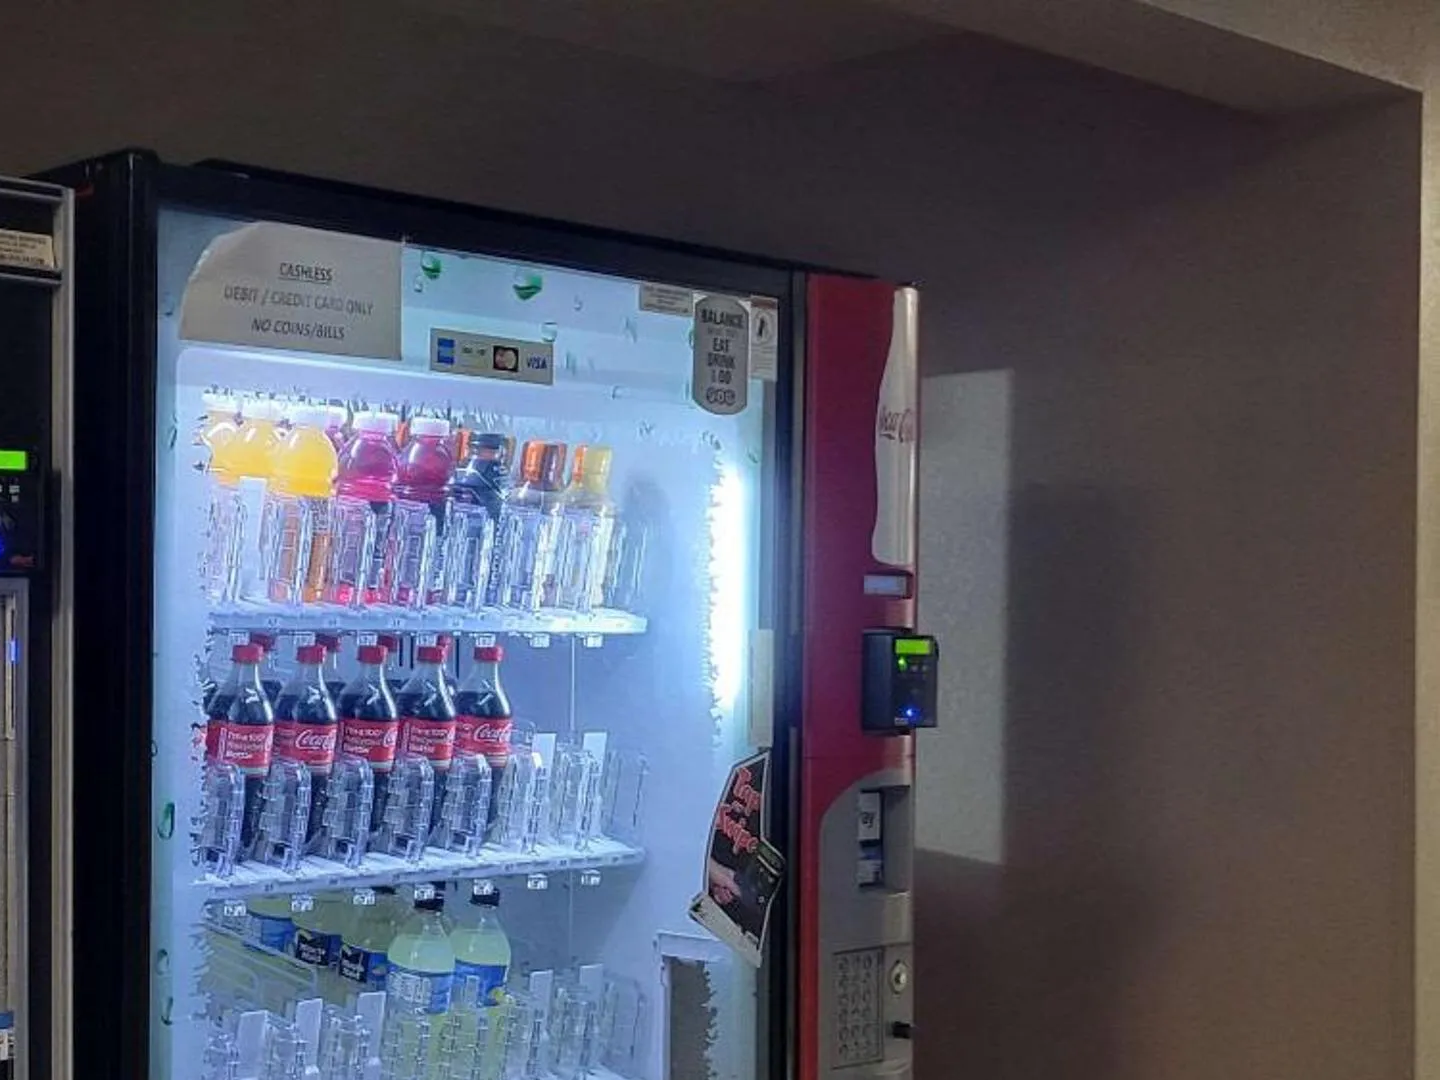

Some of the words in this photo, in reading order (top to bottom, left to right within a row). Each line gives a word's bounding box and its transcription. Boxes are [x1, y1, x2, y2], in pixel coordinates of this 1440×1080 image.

[279, 262, 334, 282] CASHLESS
[224, 285, 259, 302] DEBIT
[345, 300, 375, 316] ONLY
[251, 317, 272, 333] NO
[273, 319, 346, 341] COINS/BILLS
